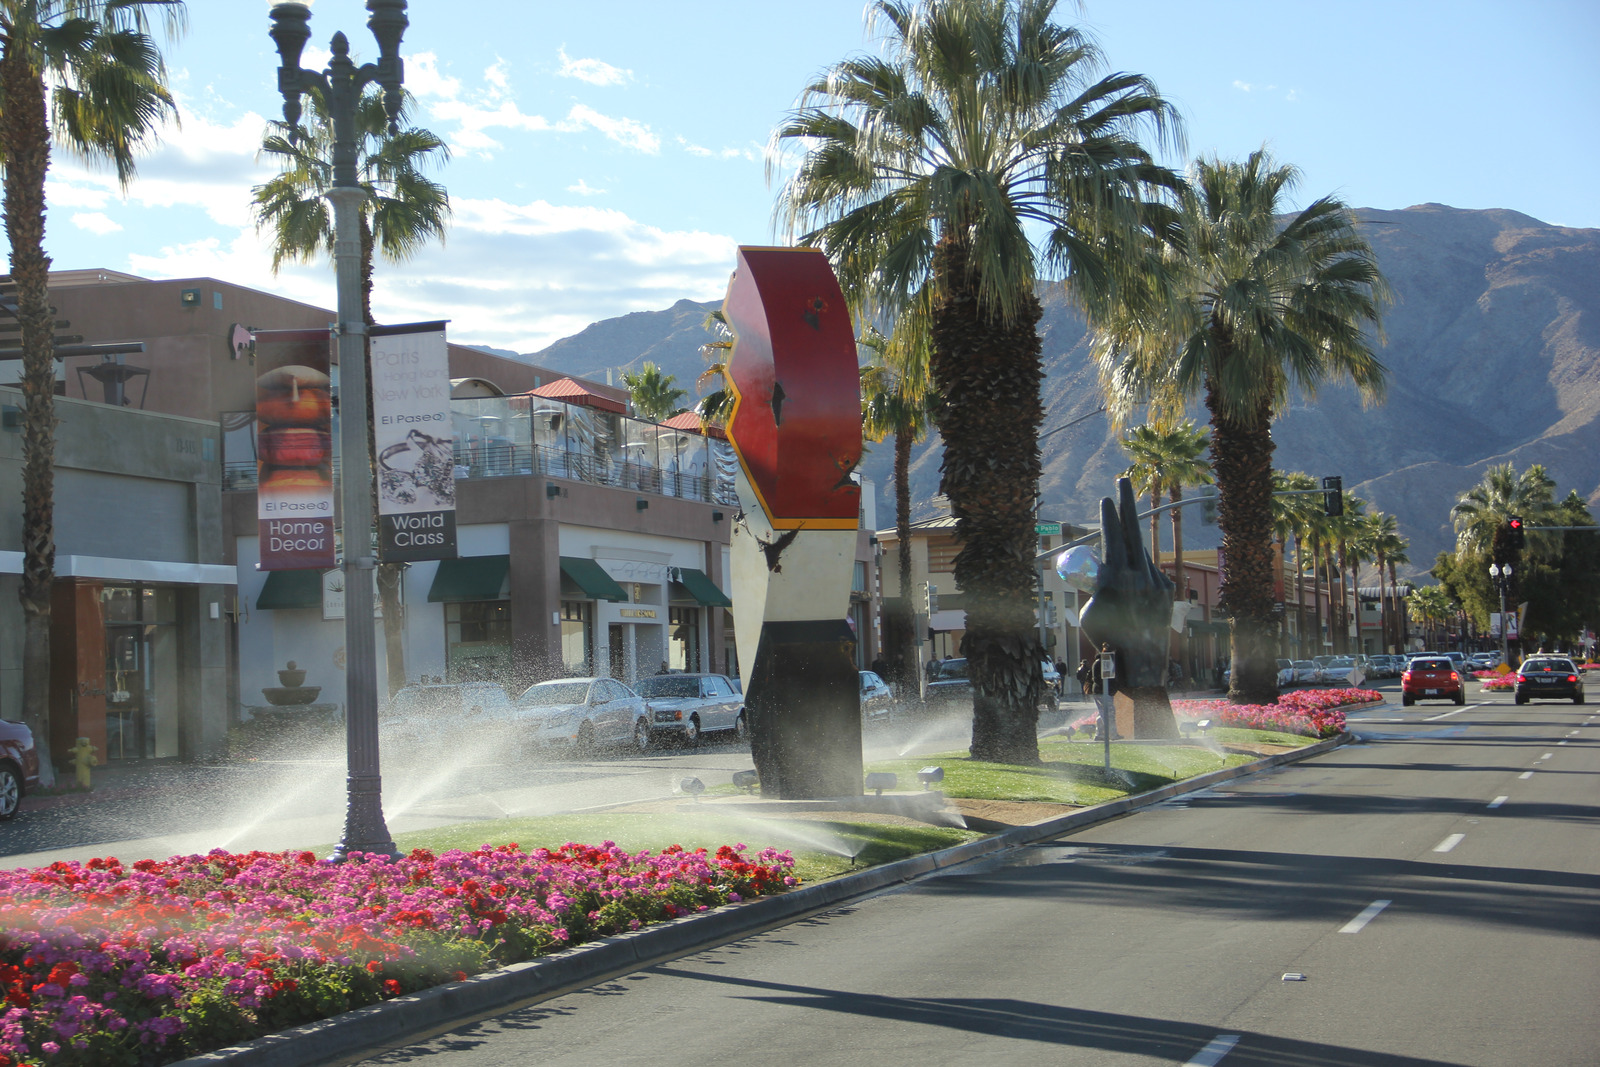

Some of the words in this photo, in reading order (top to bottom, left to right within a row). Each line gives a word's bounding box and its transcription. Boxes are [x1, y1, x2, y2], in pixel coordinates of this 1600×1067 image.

[375, 350, 419, 367] Paris
[384, 371, 416, 382] Hong
[375, 388, 409, 402] New
[412, 385, 444, 399] York
[381, 416, 393, 425] El
[397, 412, 445, 424] Paseo
[265, 502, 276, 511] El
[280, 501, 327, 511] Paseo
[270, 521, 325, 536] Home
[391, 513, 444, 530] World
[270, 537, 325, 552] Decor
[394, 531, 444, 547] Class
